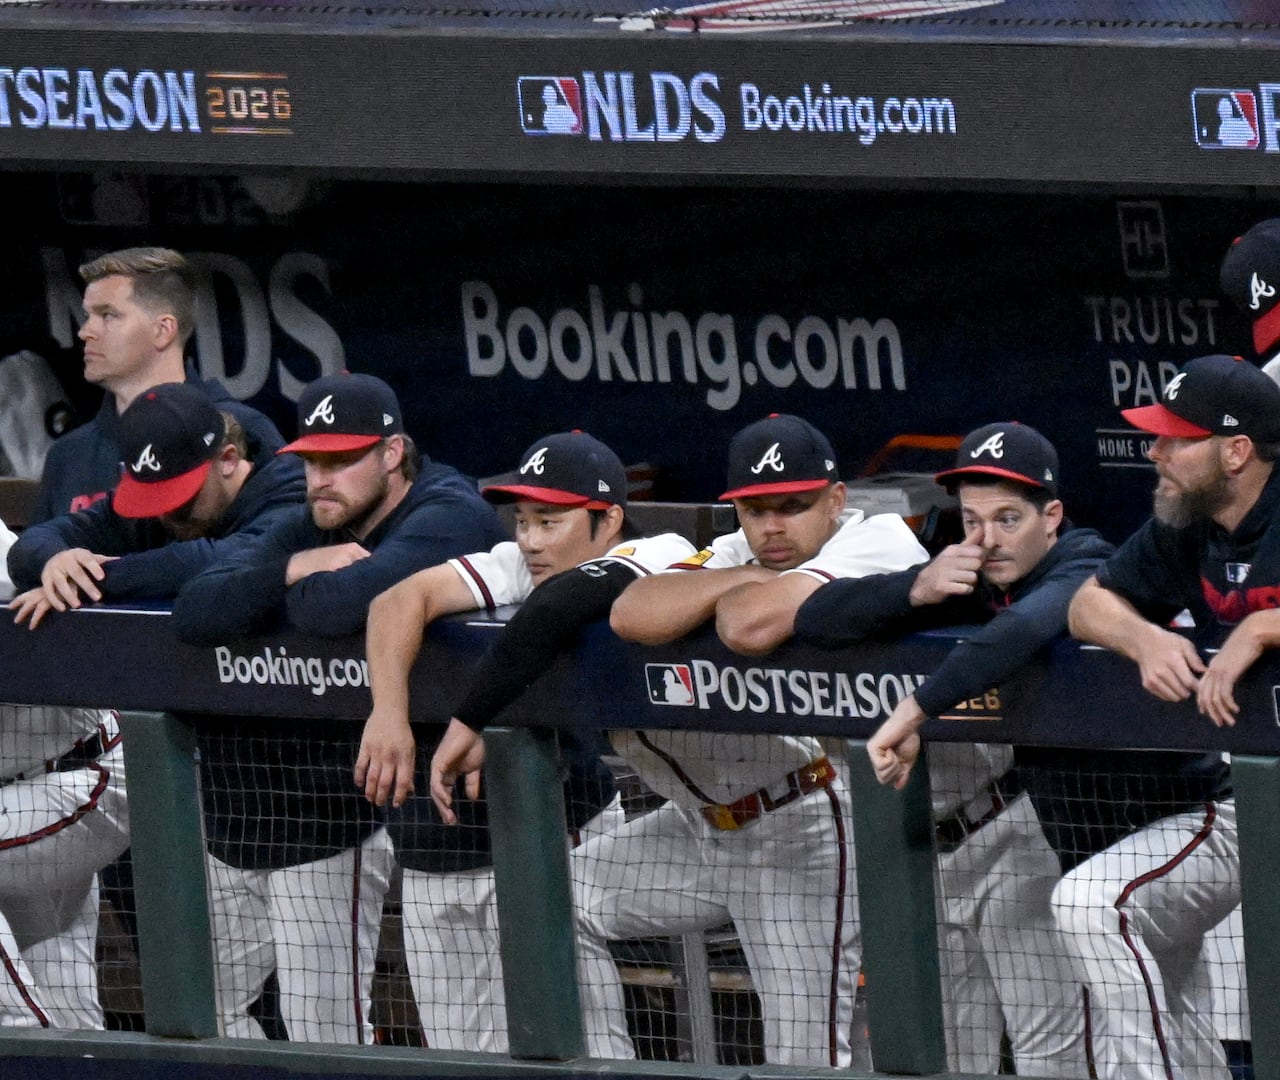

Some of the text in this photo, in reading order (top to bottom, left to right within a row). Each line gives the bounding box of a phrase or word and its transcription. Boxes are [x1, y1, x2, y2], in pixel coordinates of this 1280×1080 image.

[206, 86, 293, 120] 2026
[582, 70, 957, 145] NLDS Booking.com
[461, 280, 907, 411] Booking.com
[1086, 297, 1219, 347] TRUIST
[1099, 438, 1134, 457] HOME
